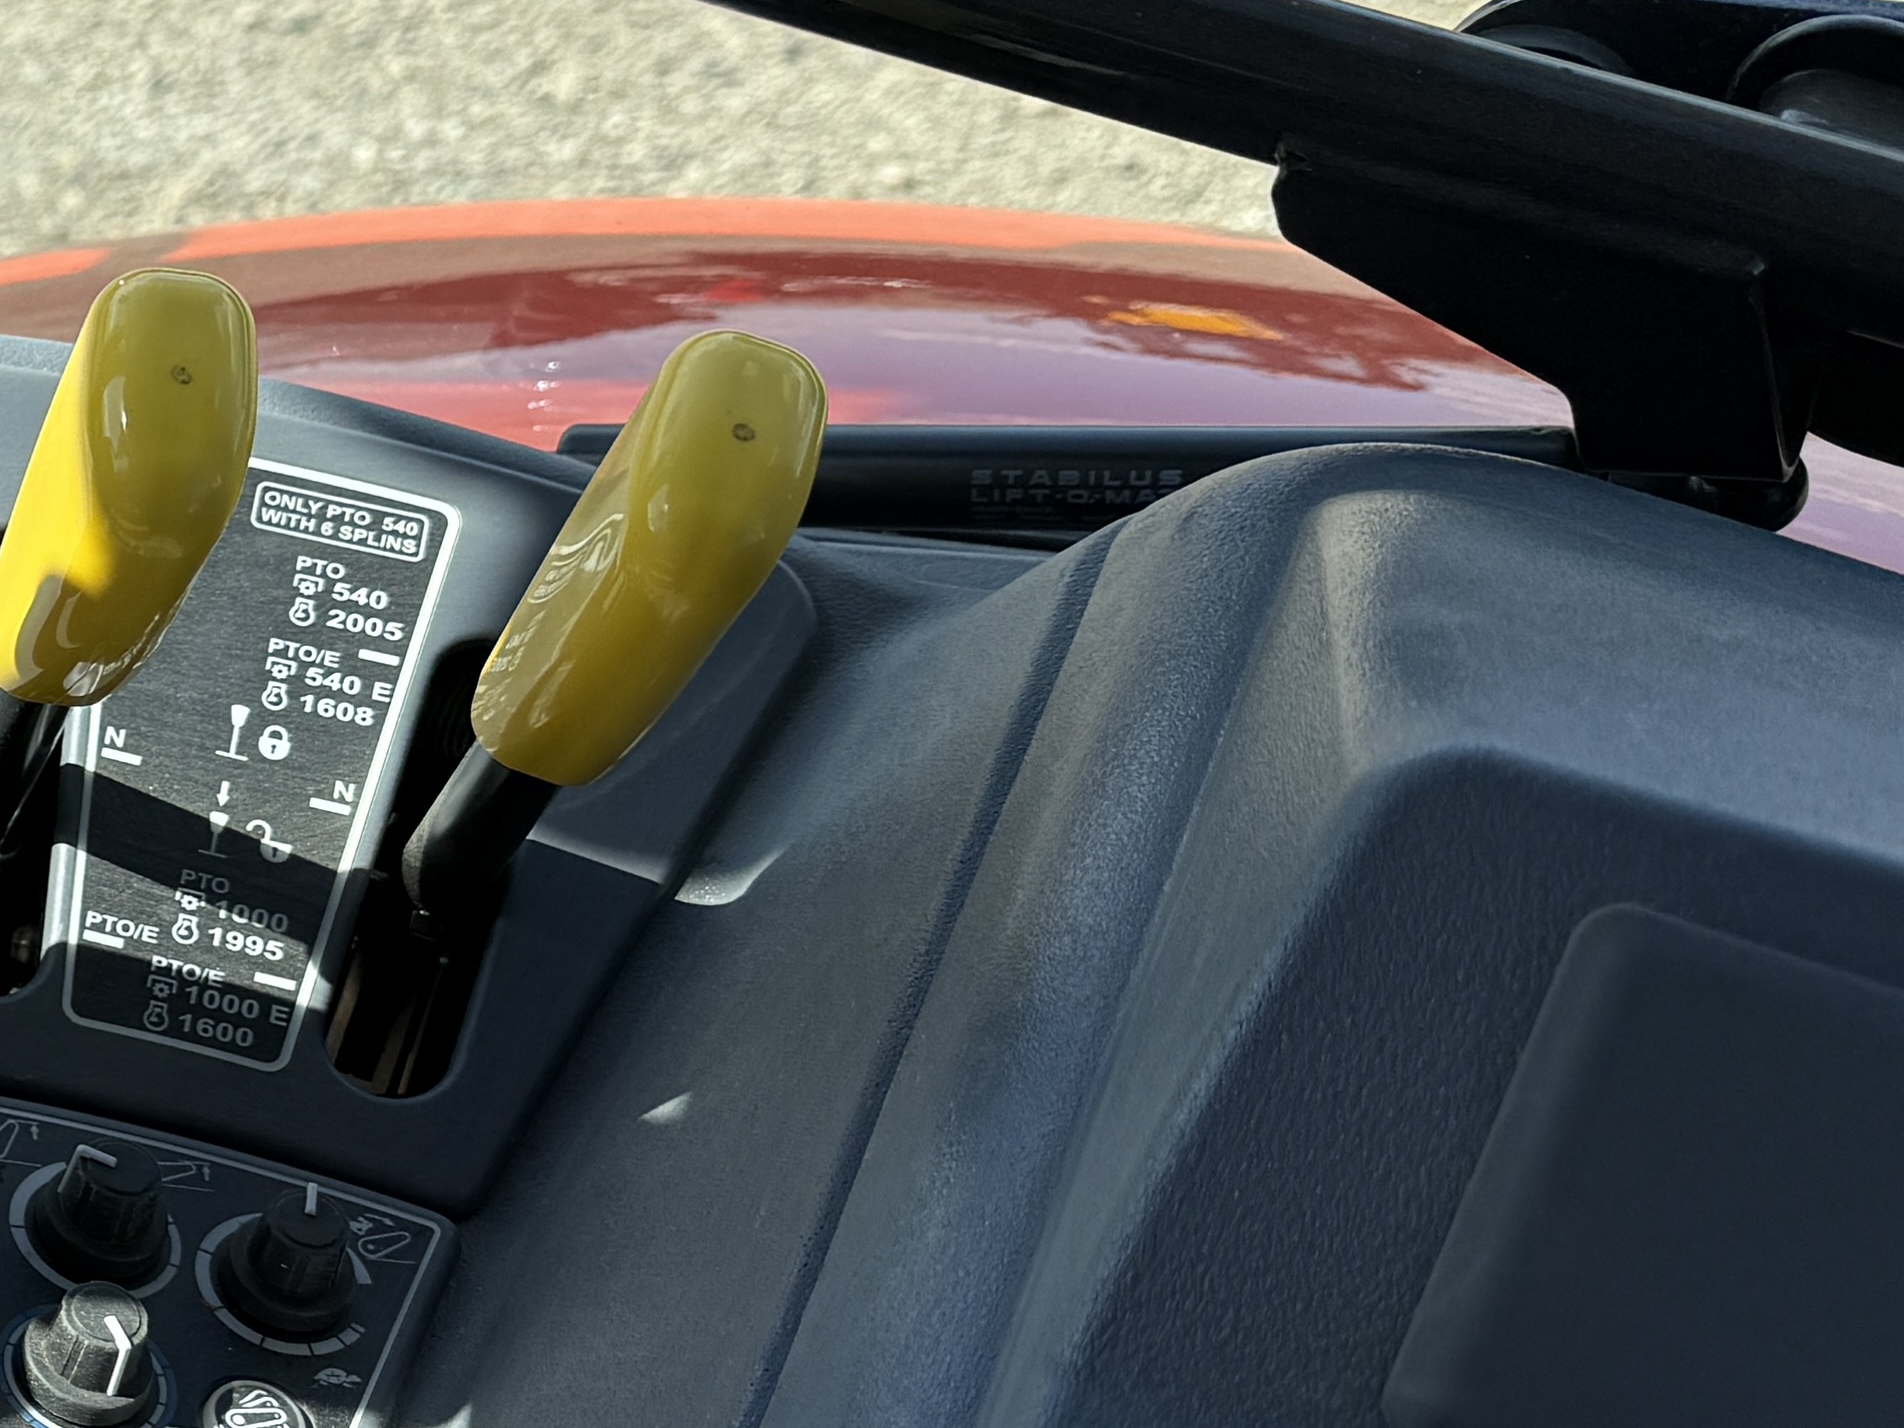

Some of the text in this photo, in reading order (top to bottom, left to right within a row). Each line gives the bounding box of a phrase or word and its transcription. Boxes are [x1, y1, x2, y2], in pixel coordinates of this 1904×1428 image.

[970, 468, 1184, 486] STABILUS
[264, 491, 418, 536] ONLY PTO 540
[262, 507, 417, 554] WITH 6 SPLINS
[296, 556, 345, 579] PTO
[332, 583, 388, 610] 540
[326, 609, 405, 641] 2005
[268, 638, 341, 668] PTO/E
[304, 667, 393, 703] 540 E
[300, 694, 374, 726] 1608
[103, 728, 127, 749] N
[333, 780, 356, 802] N
[180, 869, 230, 893] PTO
[85, 910, 160, 944] PTO/E
[215, 900, 289, 932] 1000
[208, 927, 284, 960] 1995
[151, 955, 226, 988] PTO/E
[185, 985, 290, 1026] 1000 E
[178, 1013, 254, 1047] 1600
